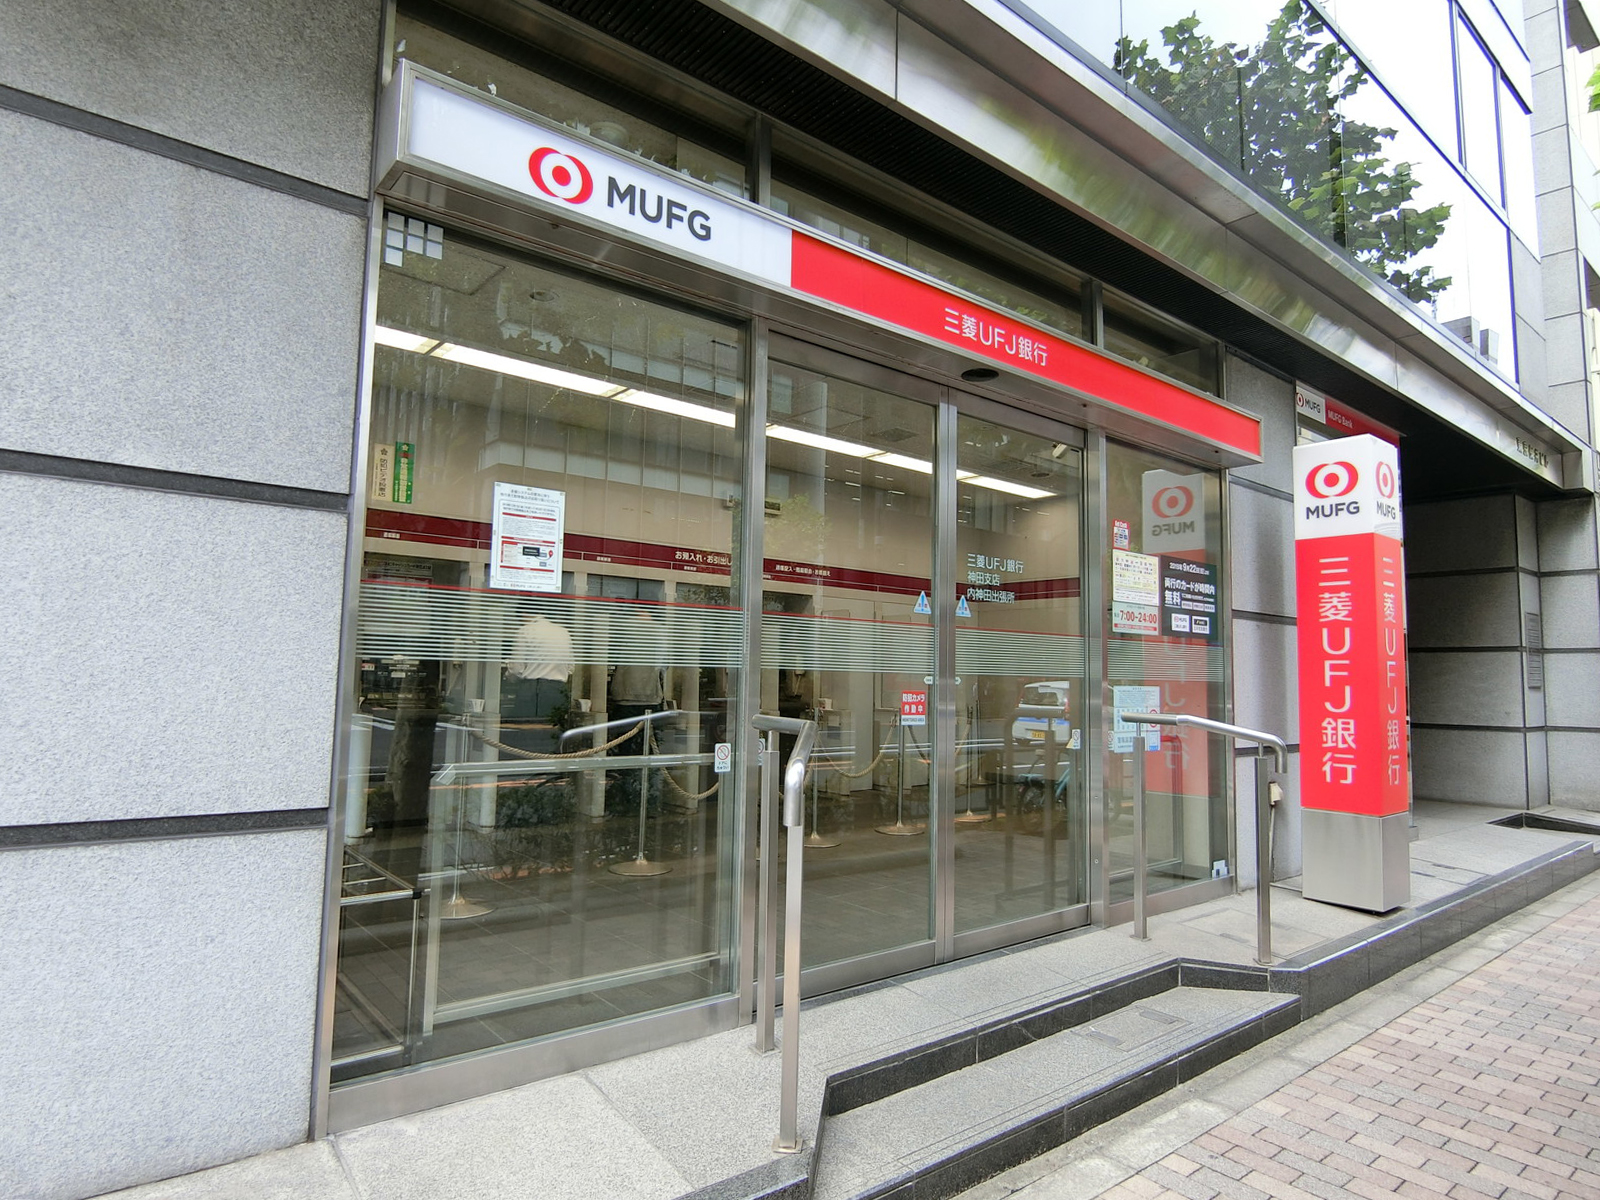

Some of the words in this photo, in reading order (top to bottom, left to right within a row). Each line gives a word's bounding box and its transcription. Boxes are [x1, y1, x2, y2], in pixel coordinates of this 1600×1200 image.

[607, 175, 712, 242] MUFG
[943, 306, 1049, 368] 三菱UFJ銀行
[1305, 399, 1321, 413] MUFG
[1327, 410, 1342, 424] MUFG
[1342, 416, 1353, 429] Bank
[1305, 501, 1360, 519] MUFG
[1376, 501, 1397, 520] MUFG
[967, 553, 1024, 574] 三菱UFJ銀行
[967, 570, 1001, 586] 神田支店
[1164, 577, 1215, 596] 両行のカードが時間内
[967, 587, 1015, 605] 内神田出張所
[1164, 590, 1181, 605] 無料
[1318, 556, 1358, 786] 三菱UFJ銀行
[1382, 556, 1400, 787] 三菱UFJ銀行
